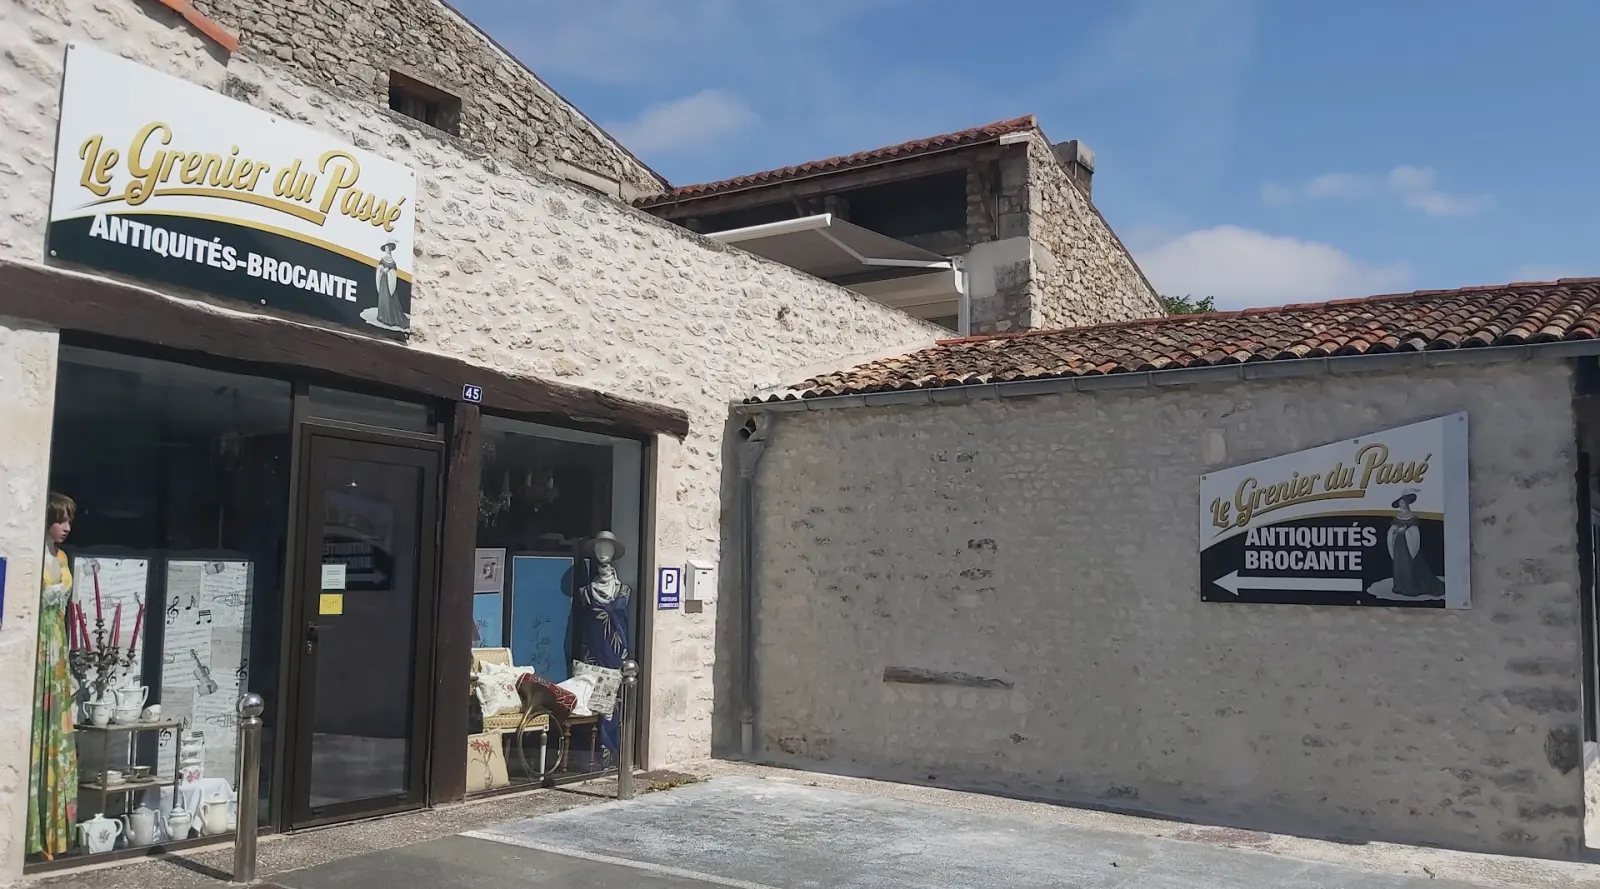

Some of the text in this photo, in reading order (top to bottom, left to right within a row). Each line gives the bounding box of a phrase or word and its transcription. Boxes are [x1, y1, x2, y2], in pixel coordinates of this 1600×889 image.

[79, 121, 406, 232] Le Grenier du Passé
[89, 213, 357, 302] ANTIQUITÉS-BROCANTE
[465, 387, 480, 400] 45
[1209, 443, 1433, 528] Le Grenier du Passé
[1245, 521, 1378, 549] ANTIQUITÉS
[1245, 550, 1363, 571] BROCANTE
[665, 573, 674, 590] P
